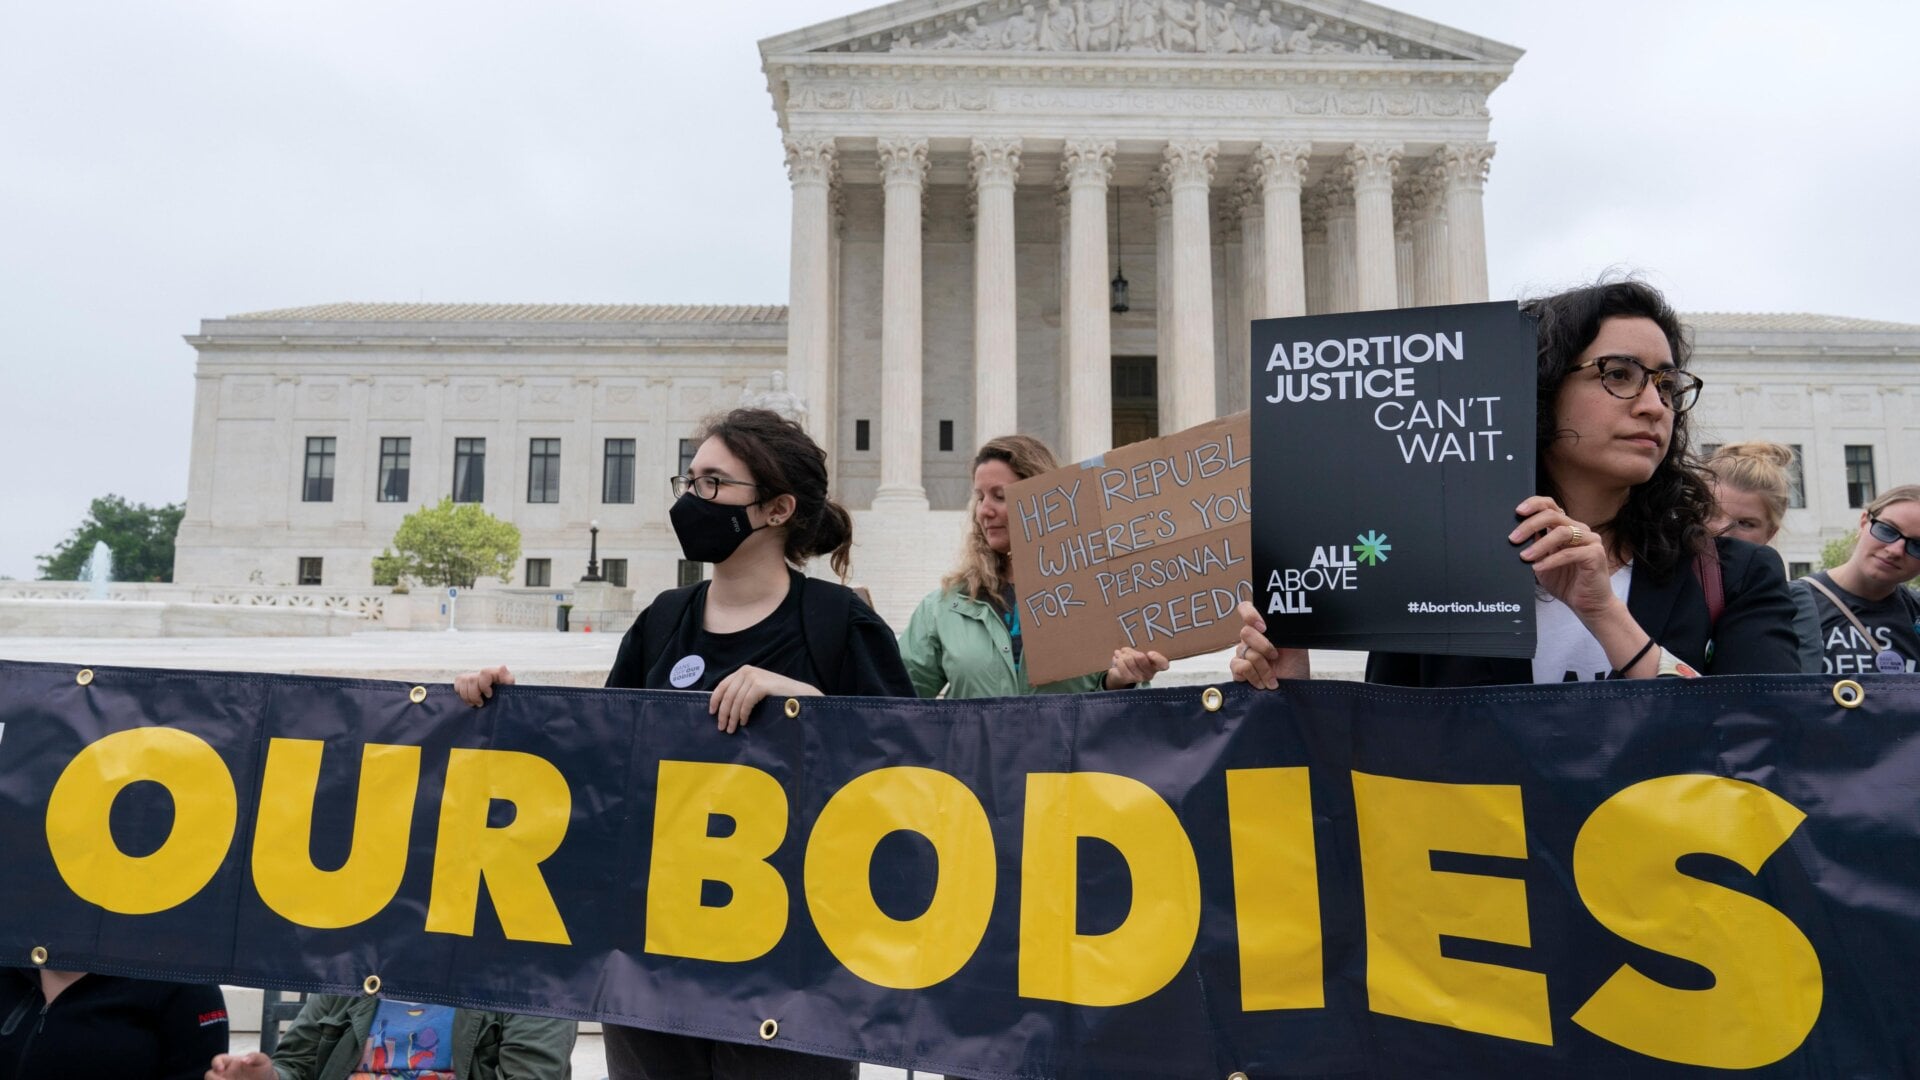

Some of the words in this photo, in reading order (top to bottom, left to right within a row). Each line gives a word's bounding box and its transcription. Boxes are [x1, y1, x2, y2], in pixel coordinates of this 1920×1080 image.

[1008, 92, 1075, 108] EQUAL
[1082, 92, 1155, 109] JUSTICE
[1165, 94, 1226, 110] UNDER
[1235, 95, 1272, 110] LAW
[1265, 331, 1464, 372] ABORTION
[1265, 367, 1415, 404] JUSTICE
[1374, 396, 1501, 431] CAN'T
[1396, 430, 1514, 464] WAIT.
[1017, 479, 1081, 542] HEY
[1100, 433, 1251, 511] REPUBL
[1037, 510, 1177, 577] WHERE'S
[1309, 545, 1357, 568] ALL
[1025, 583, 1086, 627] FOR
[1095, 538, 1245, 606] PERSONAL
[1266, 567, 1358, 592] ABOVE
[1267, 591, 1313, 614] ALL
[1407, 601, 1521, 613] #AbortionJustice
[1822, 626, 1893, 650] ANS
[46, 727, 572, 945] OUR
[645, 760, 1823, 1069] BODIES
